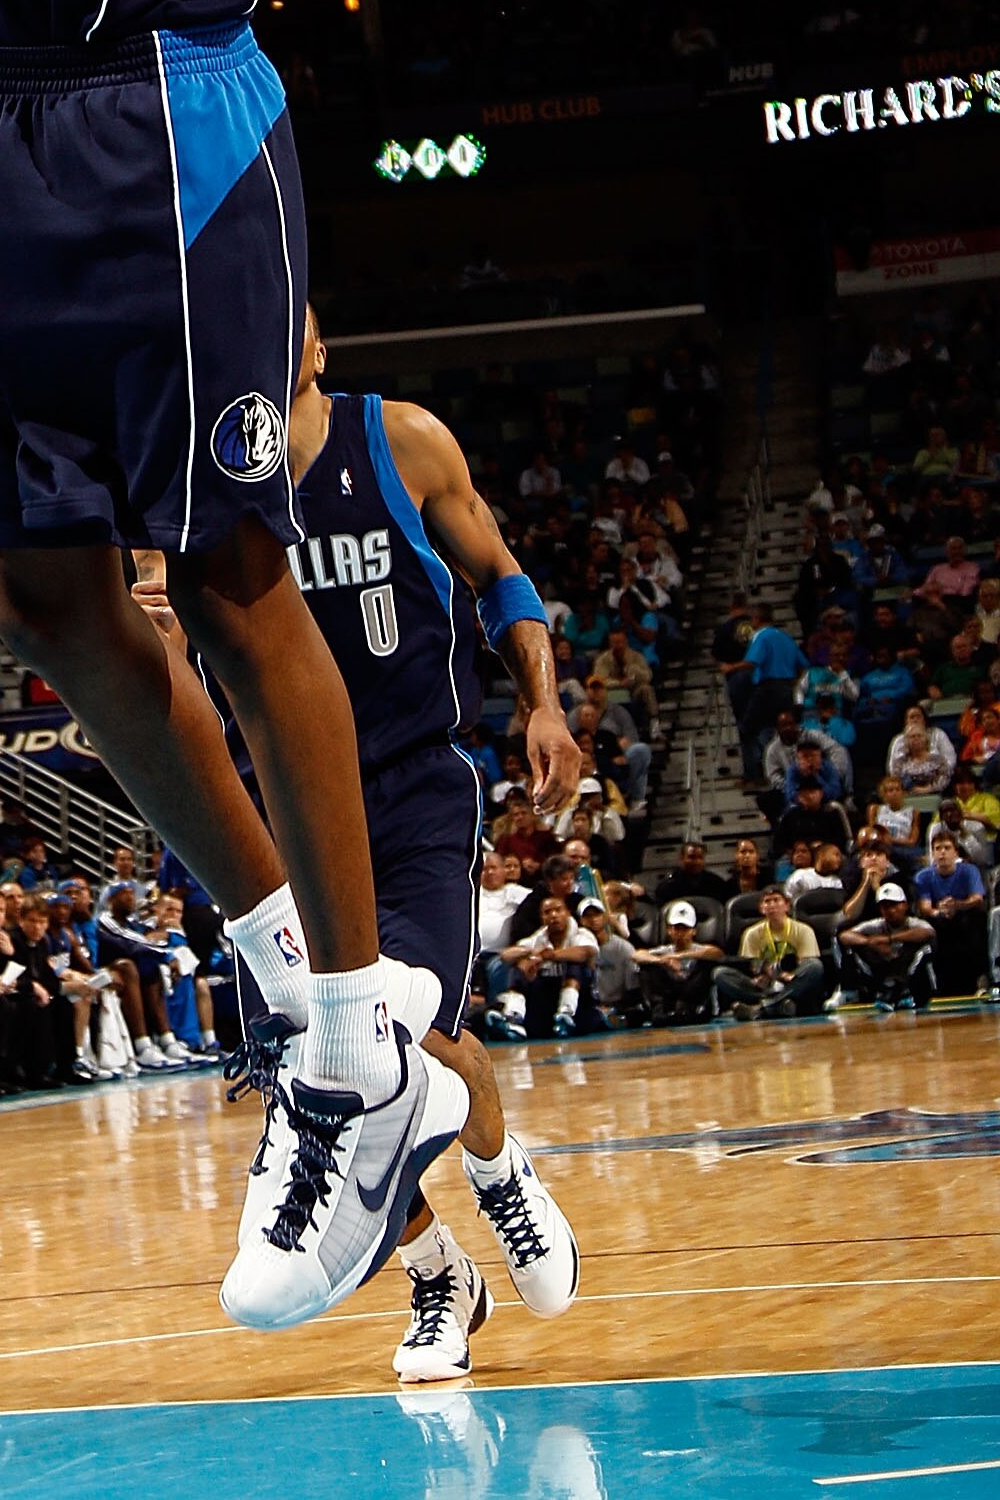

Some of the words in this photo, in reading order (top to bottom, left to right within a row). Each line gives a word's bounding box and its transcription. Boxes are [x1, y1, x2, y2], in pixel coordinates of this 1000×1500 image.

[538, 92, 601, 121] CLUB
[763, 69, 1000, 144] RICHARD'S
[884, 237, 967, 260] TOYOTA
[360, 583, 399, 657] 0
